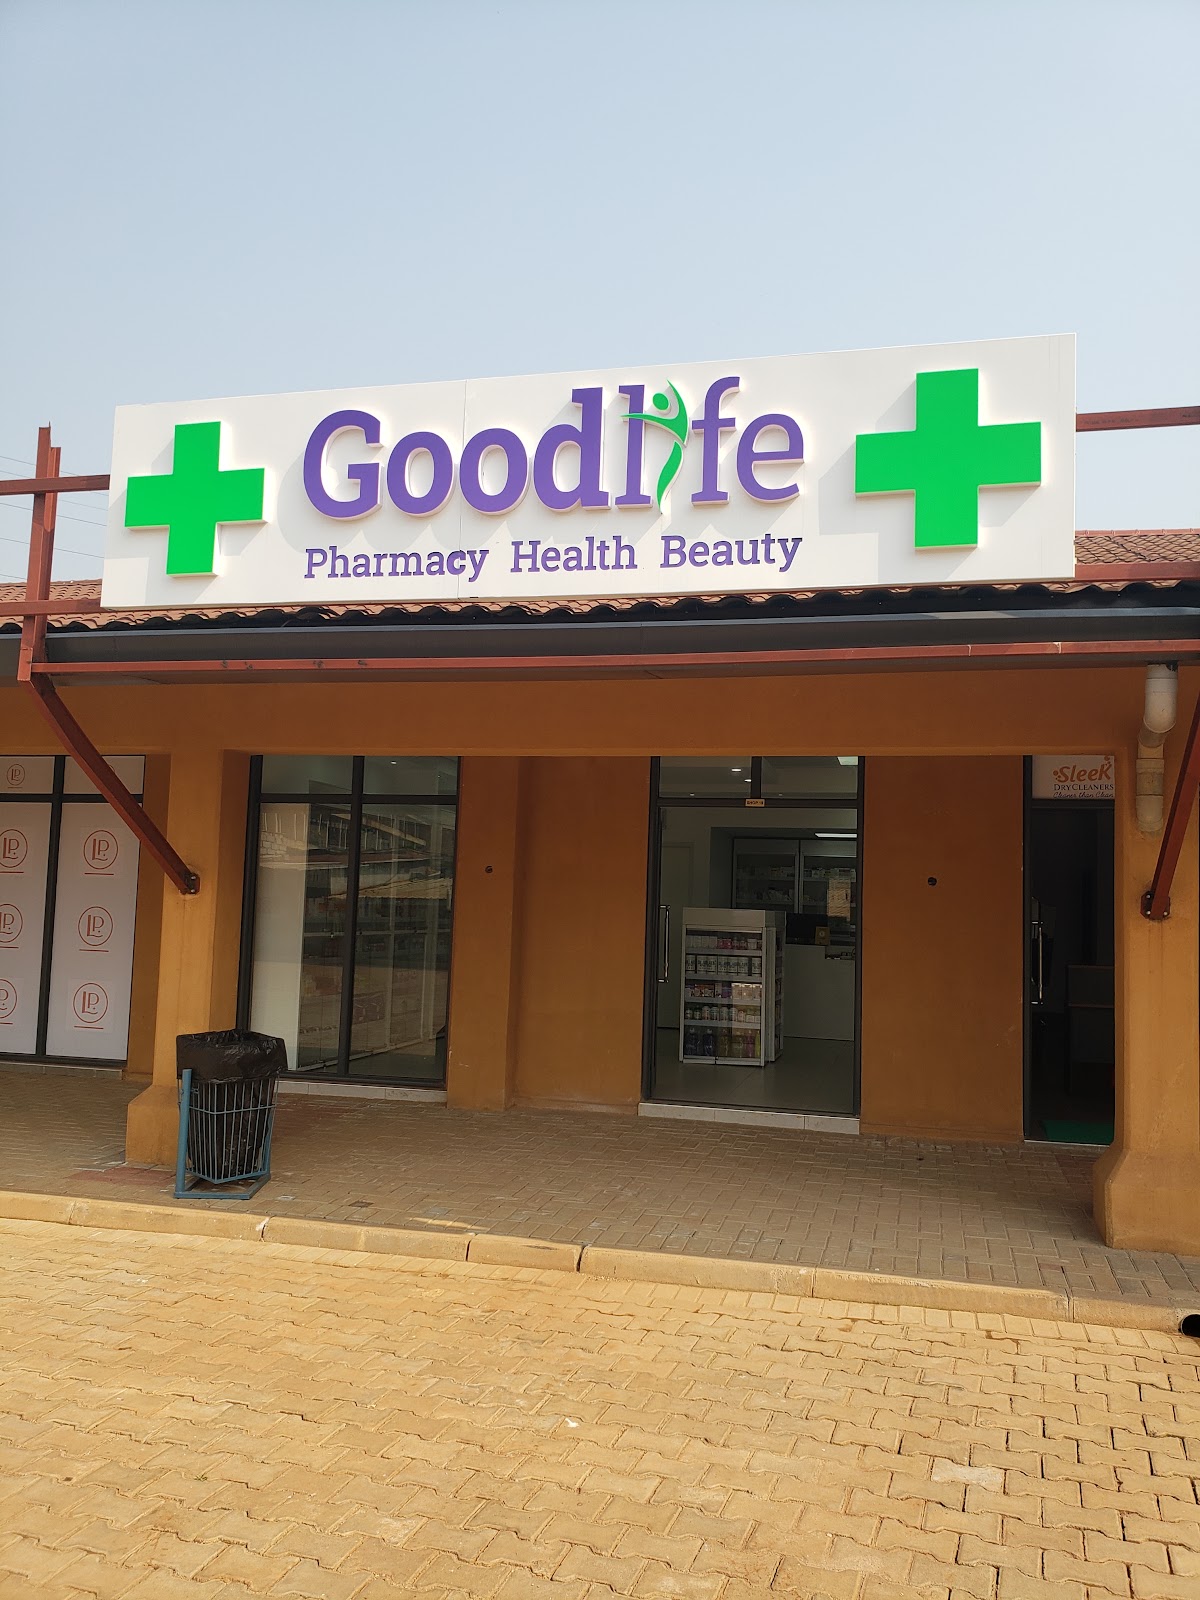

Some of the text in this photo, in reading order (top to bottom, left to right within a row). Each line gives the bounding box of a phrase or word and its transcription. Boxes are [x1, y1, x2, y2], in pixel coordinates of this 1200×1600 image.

[303, 376, 804, 520] Goodlife
[304, 533, 803, 582] Pharmacy Health Beauty
